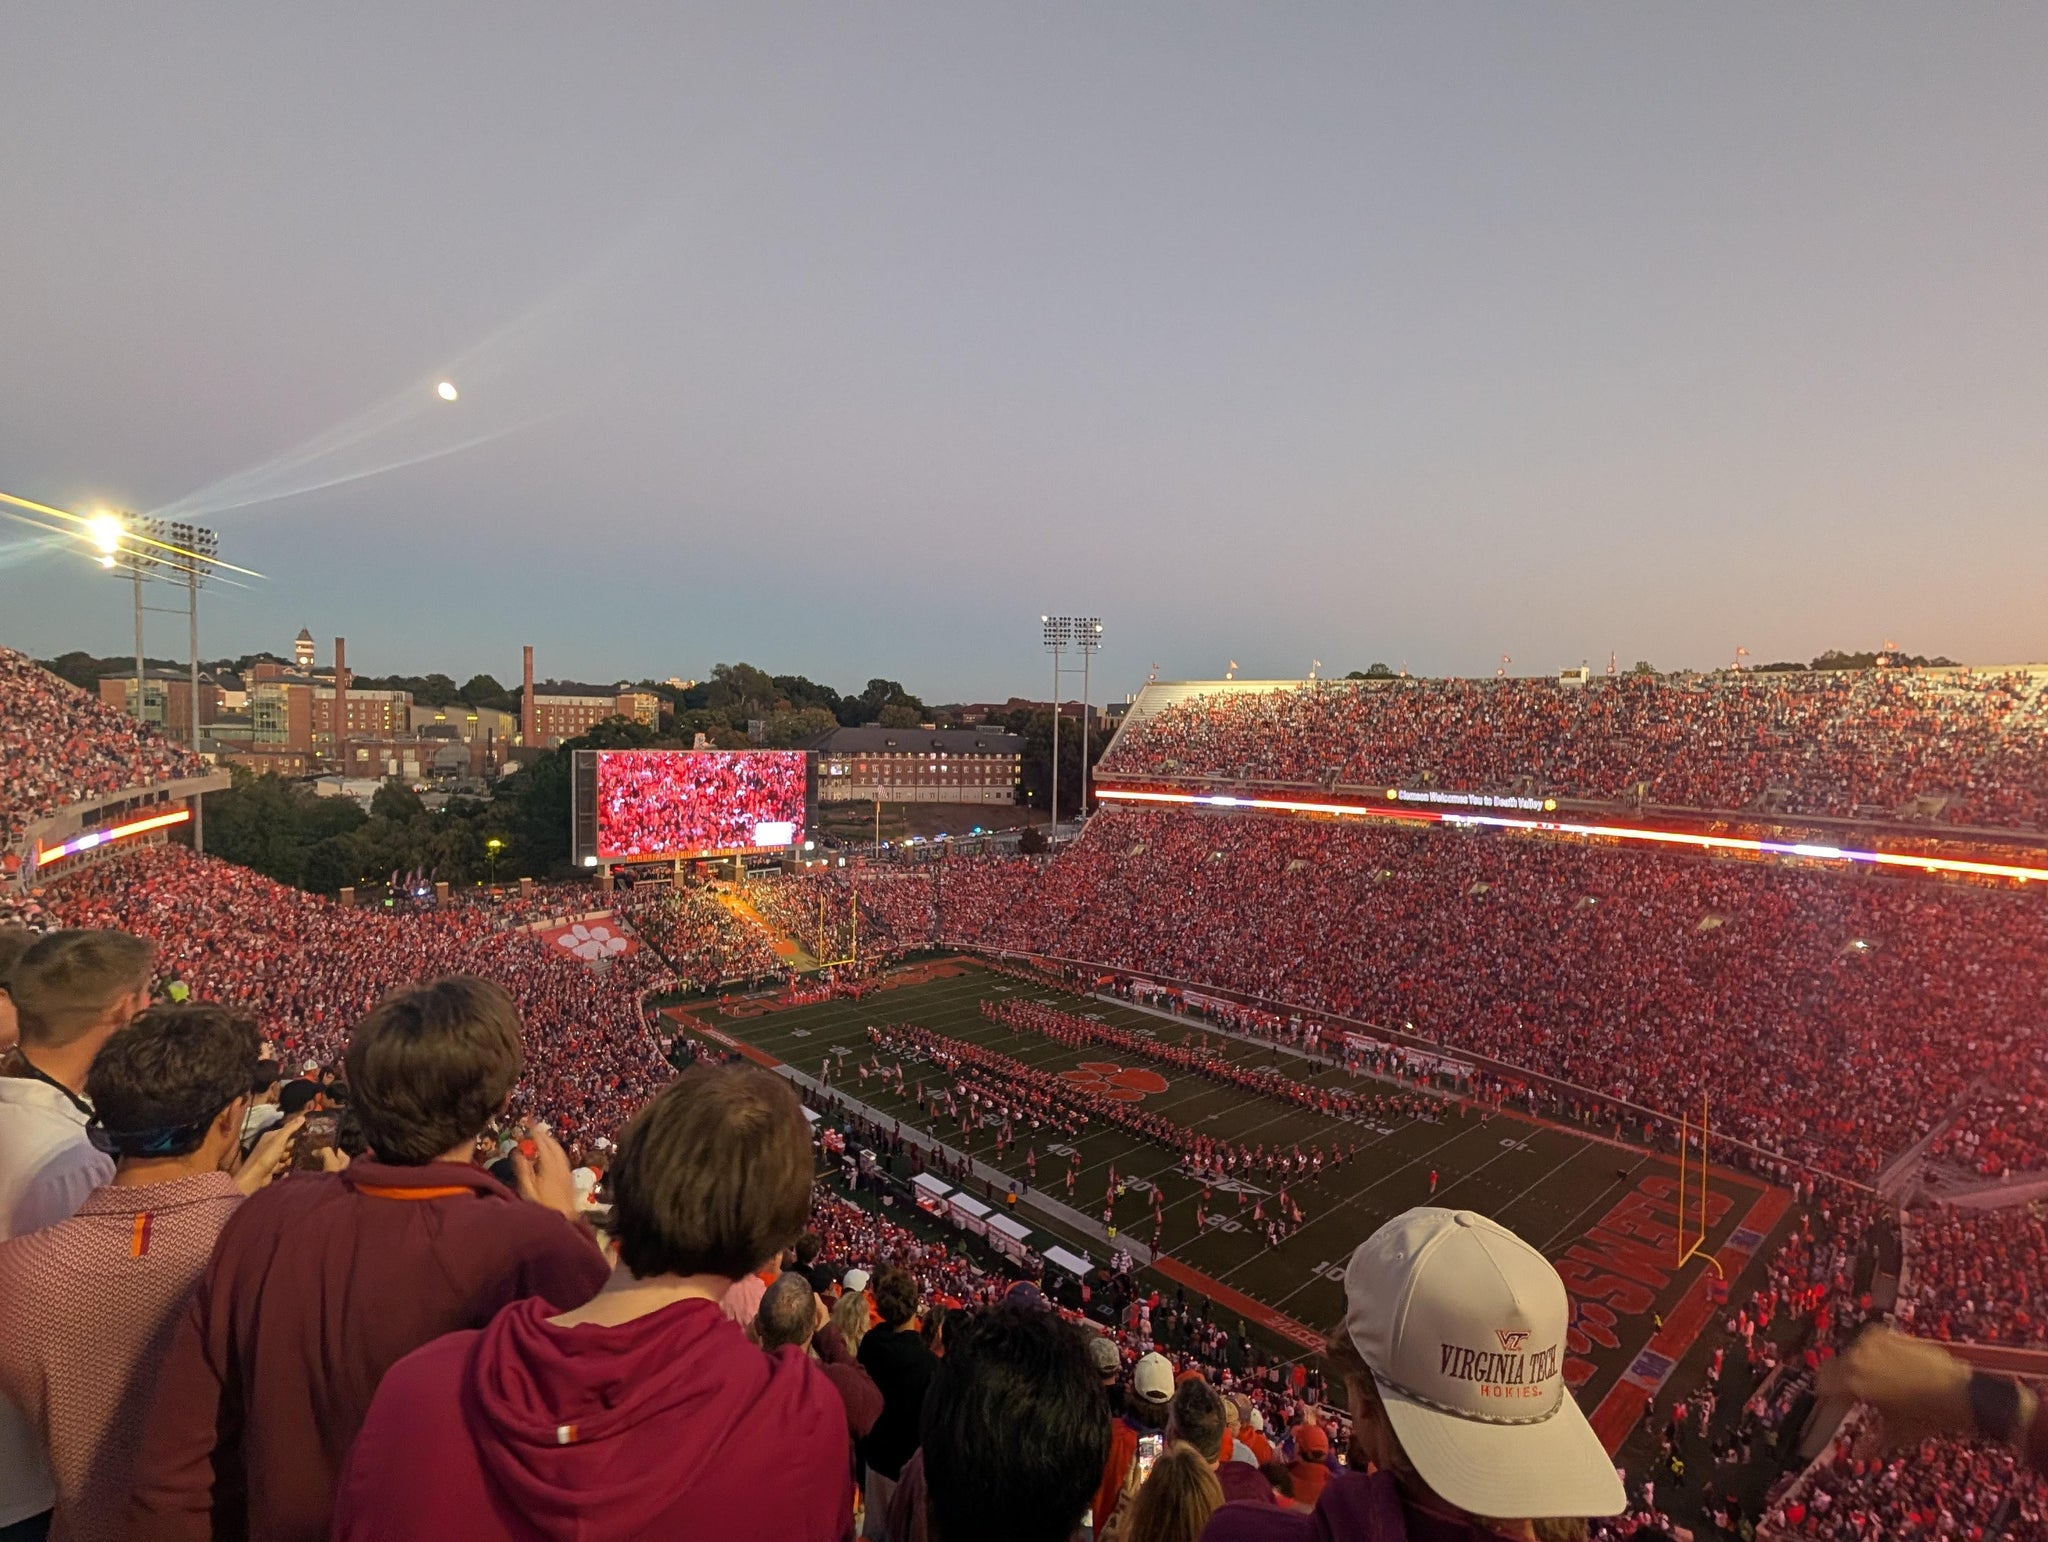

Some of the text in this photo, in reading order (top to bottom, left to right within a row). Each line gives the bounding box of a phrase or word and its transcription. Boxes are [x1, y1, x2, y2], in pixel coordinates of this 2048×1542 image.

[1429, 791, 1468, 804] Welcomes
[1468, 794, 1483, 806] You
[1484, 795, 1492, 806] to
[1493, 796, 1517, 808] Death
[1517, 797, 1543, 811] Valley
[1205, 1213, 1242, 1233] 20
[1312, 1261, 1346, 1282] 10
[1496, 1329, 1531, 1351] VT
[1441, 1343, 1558, 1385] VIRGINIA TECH
[1480, 1384, 1539, 1398] HOKIES
